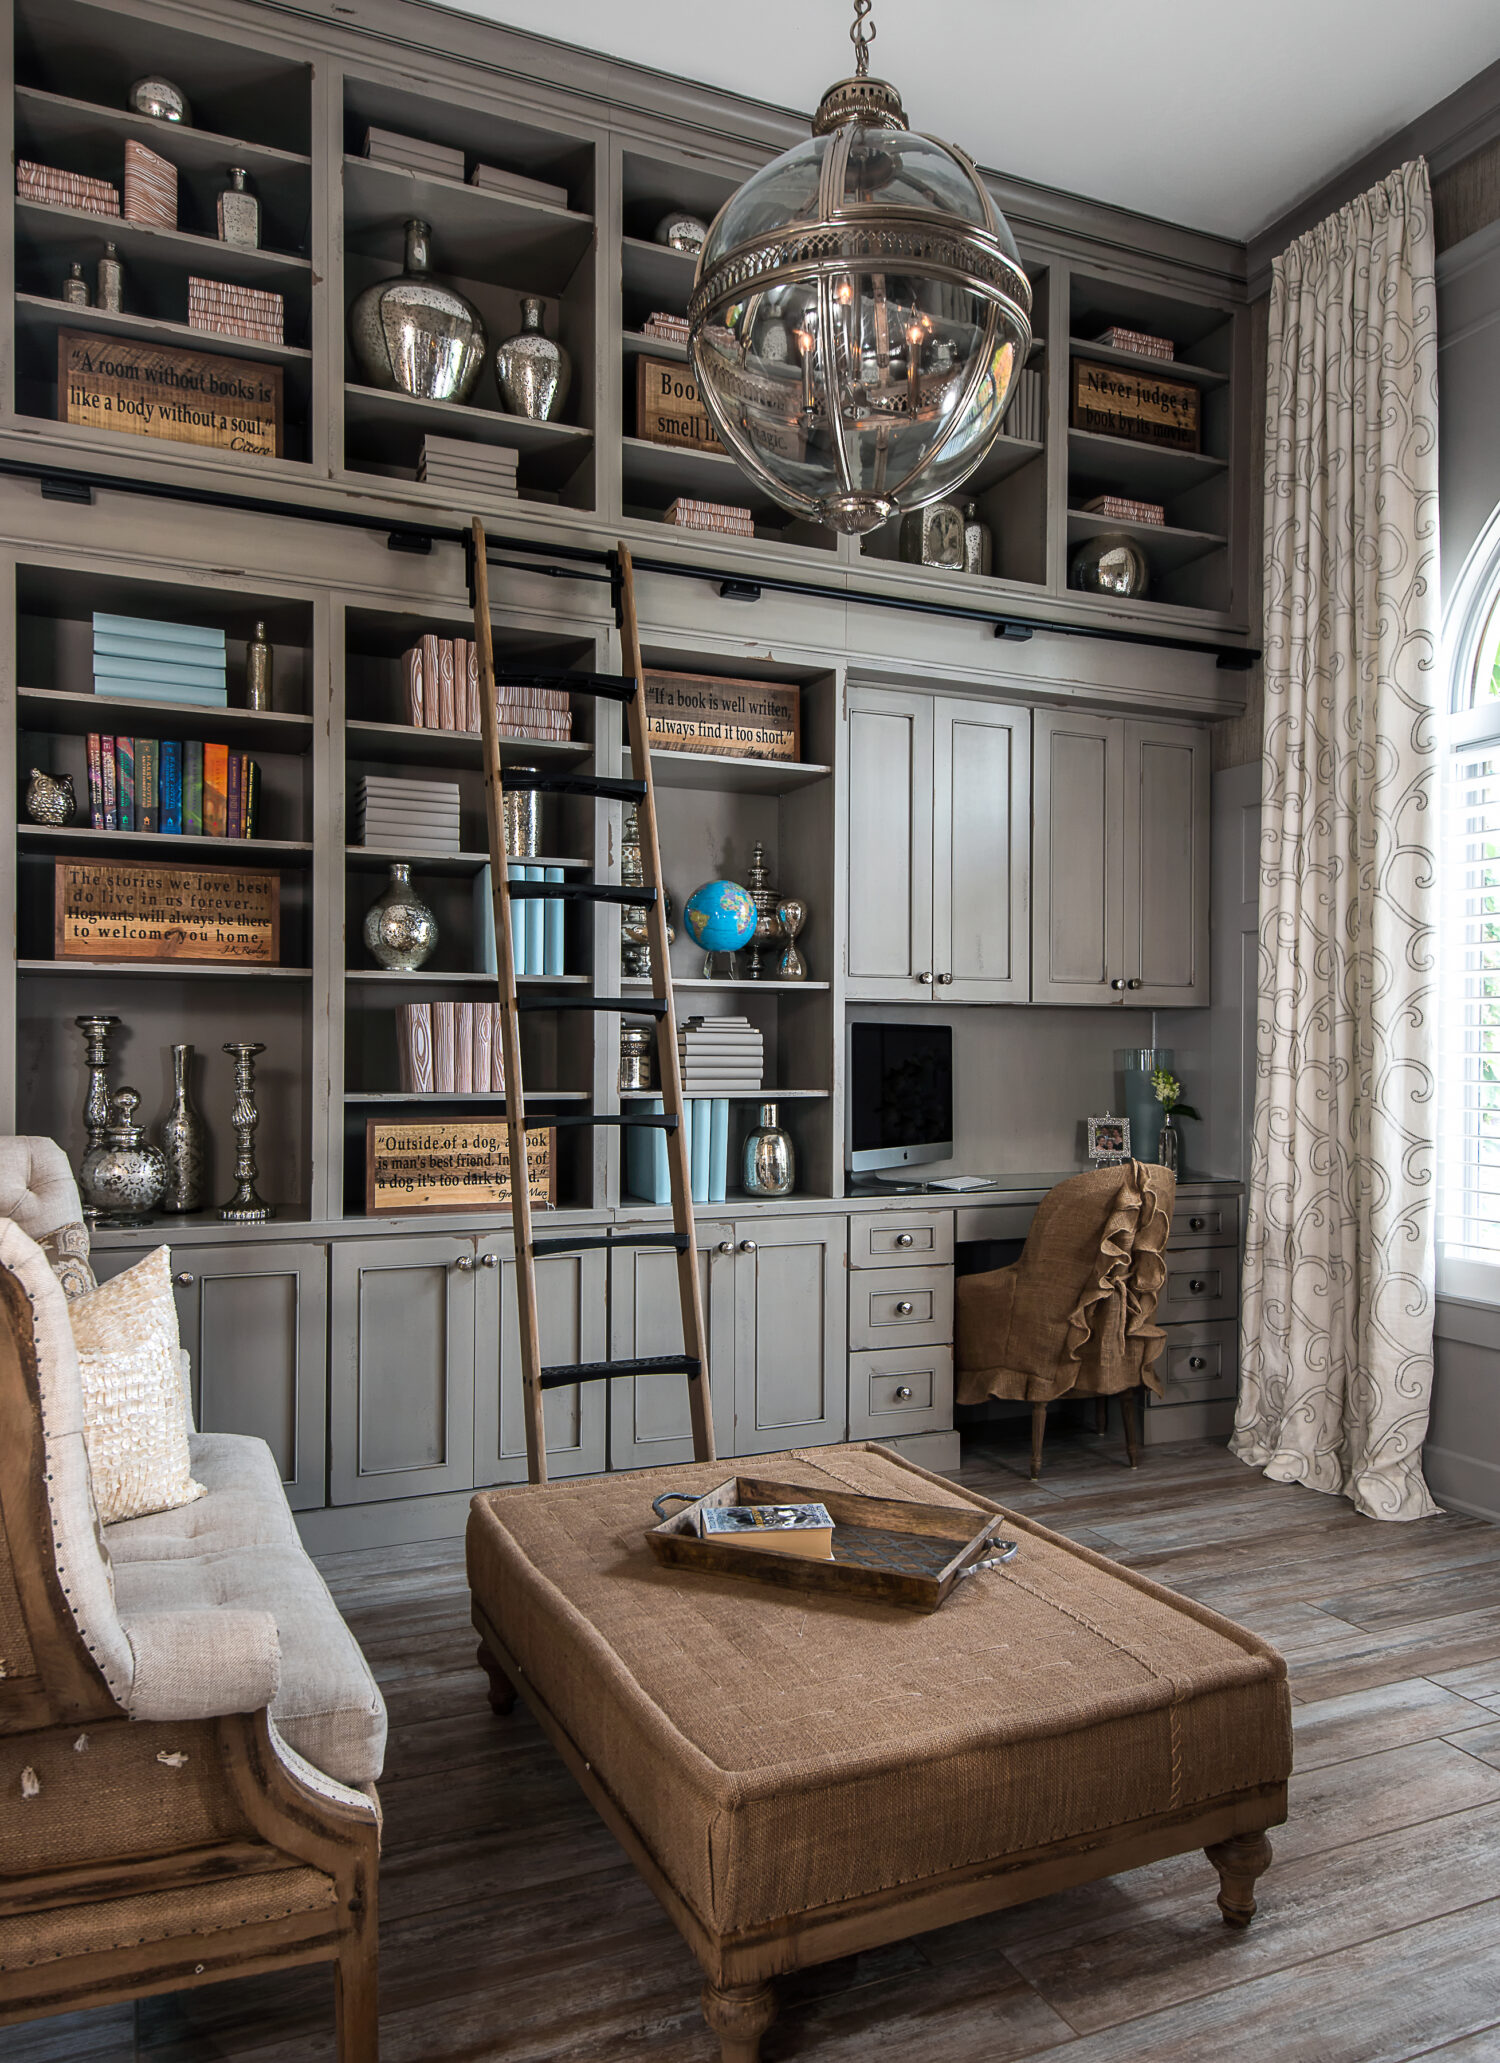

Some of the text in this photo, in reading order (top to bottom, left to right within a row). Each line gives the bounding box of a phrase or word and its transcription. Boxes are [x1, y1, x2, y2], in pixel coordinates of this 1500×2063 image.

[99, 358, 139, 380] room
[145, 366, 205, 389] without
[210, 373, 254, 400] books
[259, 383, 271, 402] is
[1088, 372, 1188, 413] Never judge a
[70, 385, 100, 408] like
[104, 397, 112, 410] a
[117, 393, 154, 422] body
[159, 402, 216, 427] without
[220, 415, 227, 429] a
[1086, 404, 1115, 428] book
[1120, 411, 1131, 433] by
[1137, 415, 1150, 433] its
[658, 416, 720, 442] smell li
[649, 687, 791, 720] “If a book is well written,
[648, 716, 652, 731] I
[656, 717, 694, 740] always
[699, 720, 721, 738] find
[725, 723, 732, 739] it
[736, 728, 752, 742] too
[70, 871, 269, 894] The stories we love best
[74, 890, 93, 903] do
[102, 890, 133, 904] live
[142, 892, 157, 905] in
[166, 896, 182, 906] us
[68, 906, 269, 928] Hogwarts will always be there
[74, 925, 264, 944] to welcome you home.
[443, 1135, 457, 1149] of
[462, 1139, 467, 1148] a
[473, 1135, 499, 1152] dog,
[526, 1133, 547, 1147] ook
[378, 1156, 387, 1169] is
[392, 1155, 426, 1169] man's
[430, 1155, 453, 1168] best
[456, 1154, 494, 1167] friend.
[536, 1151, 547, 1165] of
[379, 1171, 506, 1192] a dog it's too dark to
